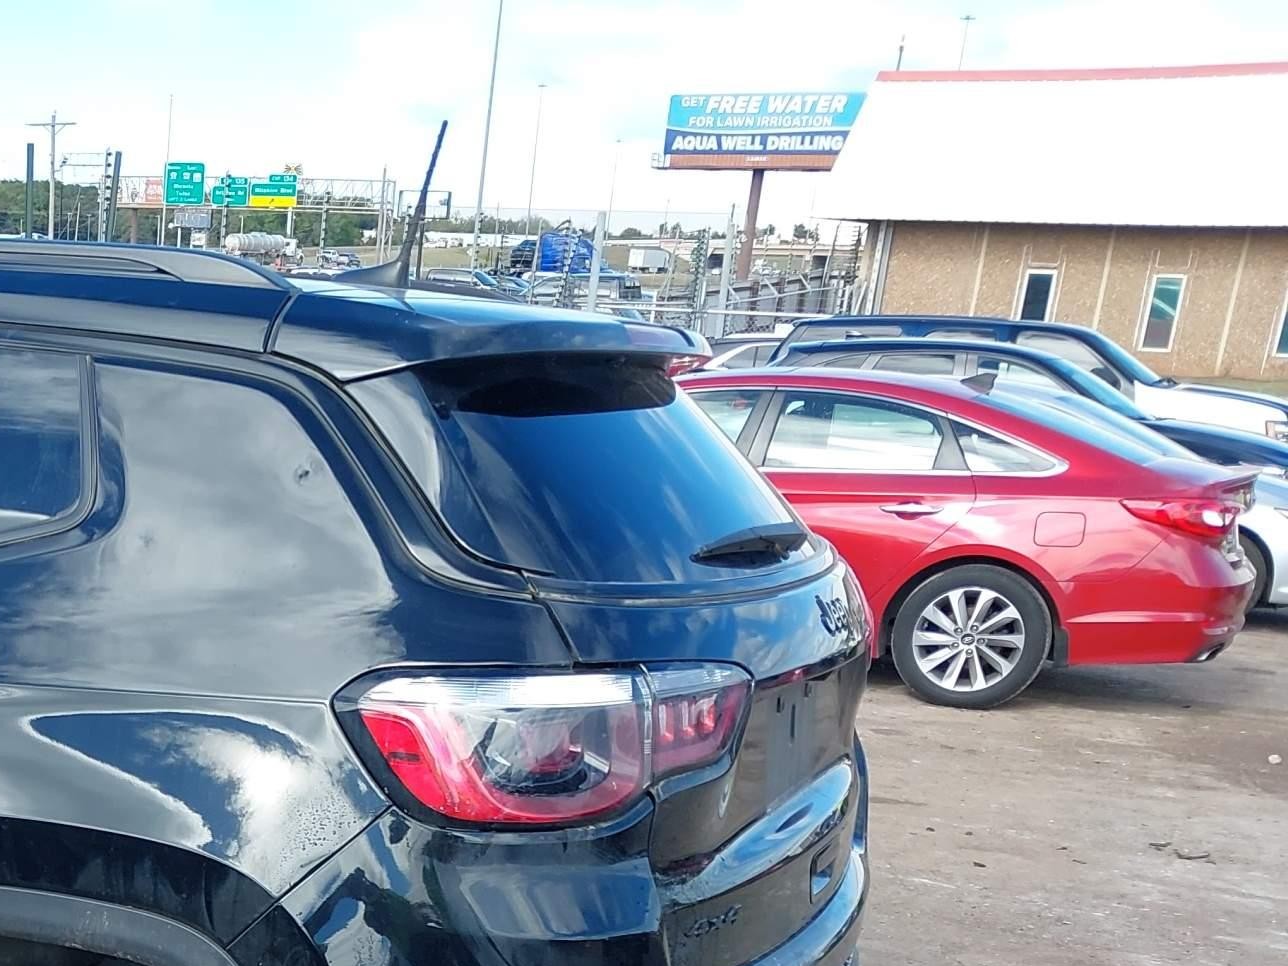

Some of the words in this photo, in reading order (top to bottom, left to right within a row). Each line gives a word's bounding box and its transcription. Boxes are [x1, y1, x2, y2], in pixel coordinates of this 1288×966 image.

[681, 96, 706, 107] GET
[705, 95, 764, 114] FREE
[767, 95, 848, 114] WATER
[688, 116, 714, 128] FOR
[716, 116, 754, 128] LAWN
[756, 115, 833, 128] IRRIGATION
[671, 135, 718, 151] AQUA
[721, 135, 764, 151] WELL
[766, 135, 844, 151] DRILLING
